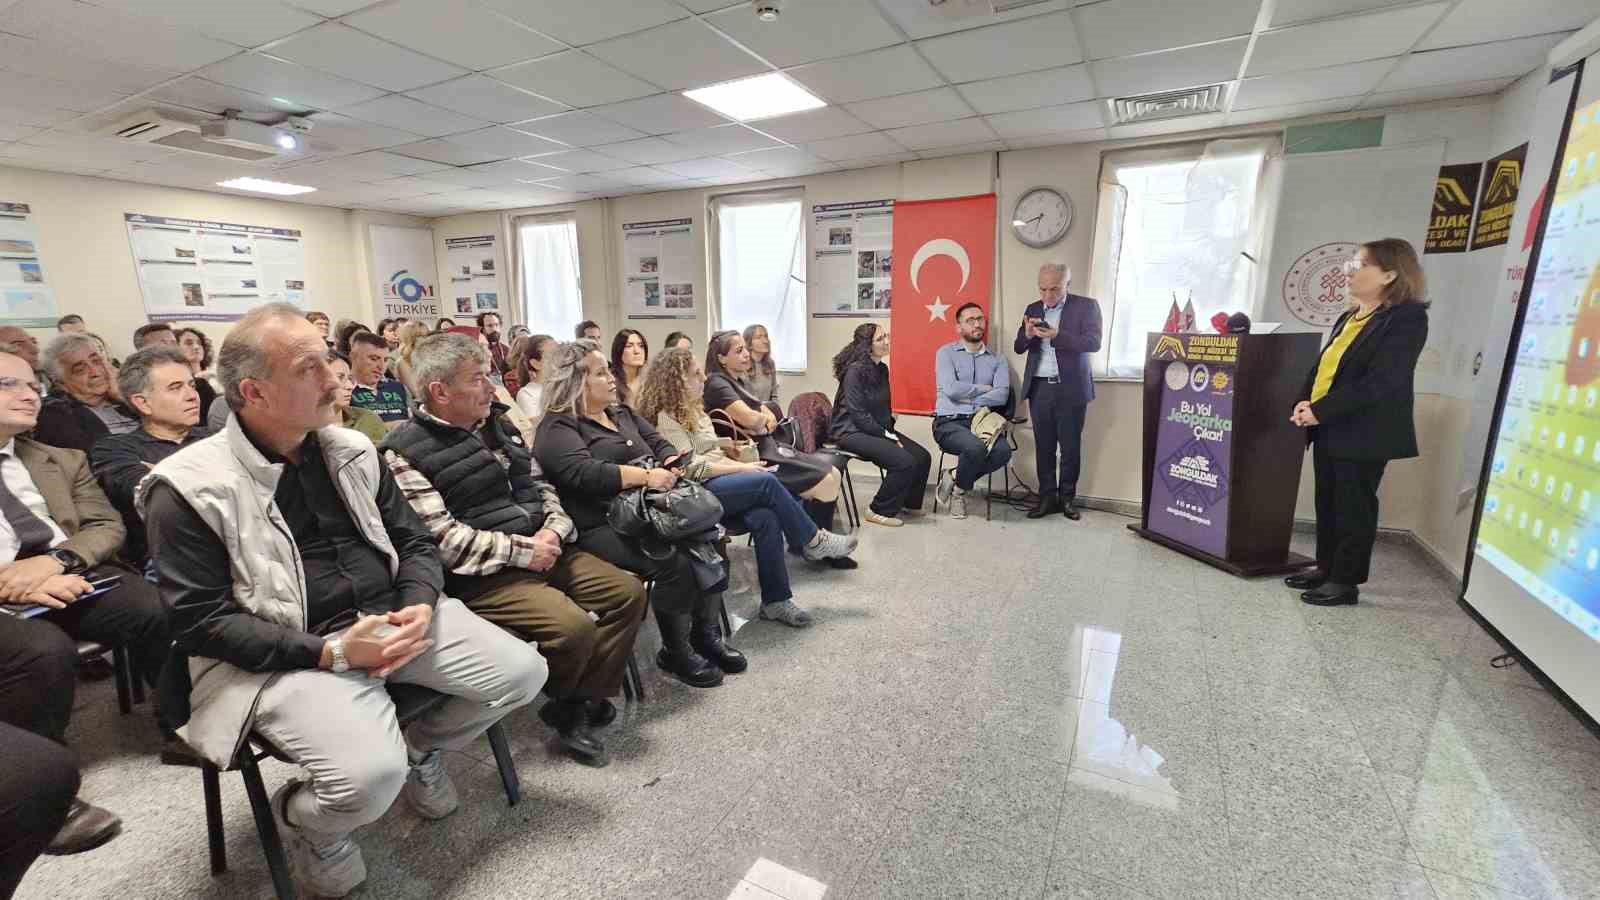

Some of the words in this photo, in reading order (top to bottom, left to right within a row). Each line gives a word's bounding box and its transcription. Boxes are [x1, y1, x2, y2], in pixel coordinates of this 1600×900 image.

[385, 302, 438, 315] TÜRKİYE
[1188, 335, 1239, 347] ZONGULDAK
[1180, 400, 1195, 414] Bu
[1196, 402, 1212, 417] Yol
[1168, 407, 1232, 431] Jeoparka
[1170, 463, 1218, 484] ZONGULDAK
